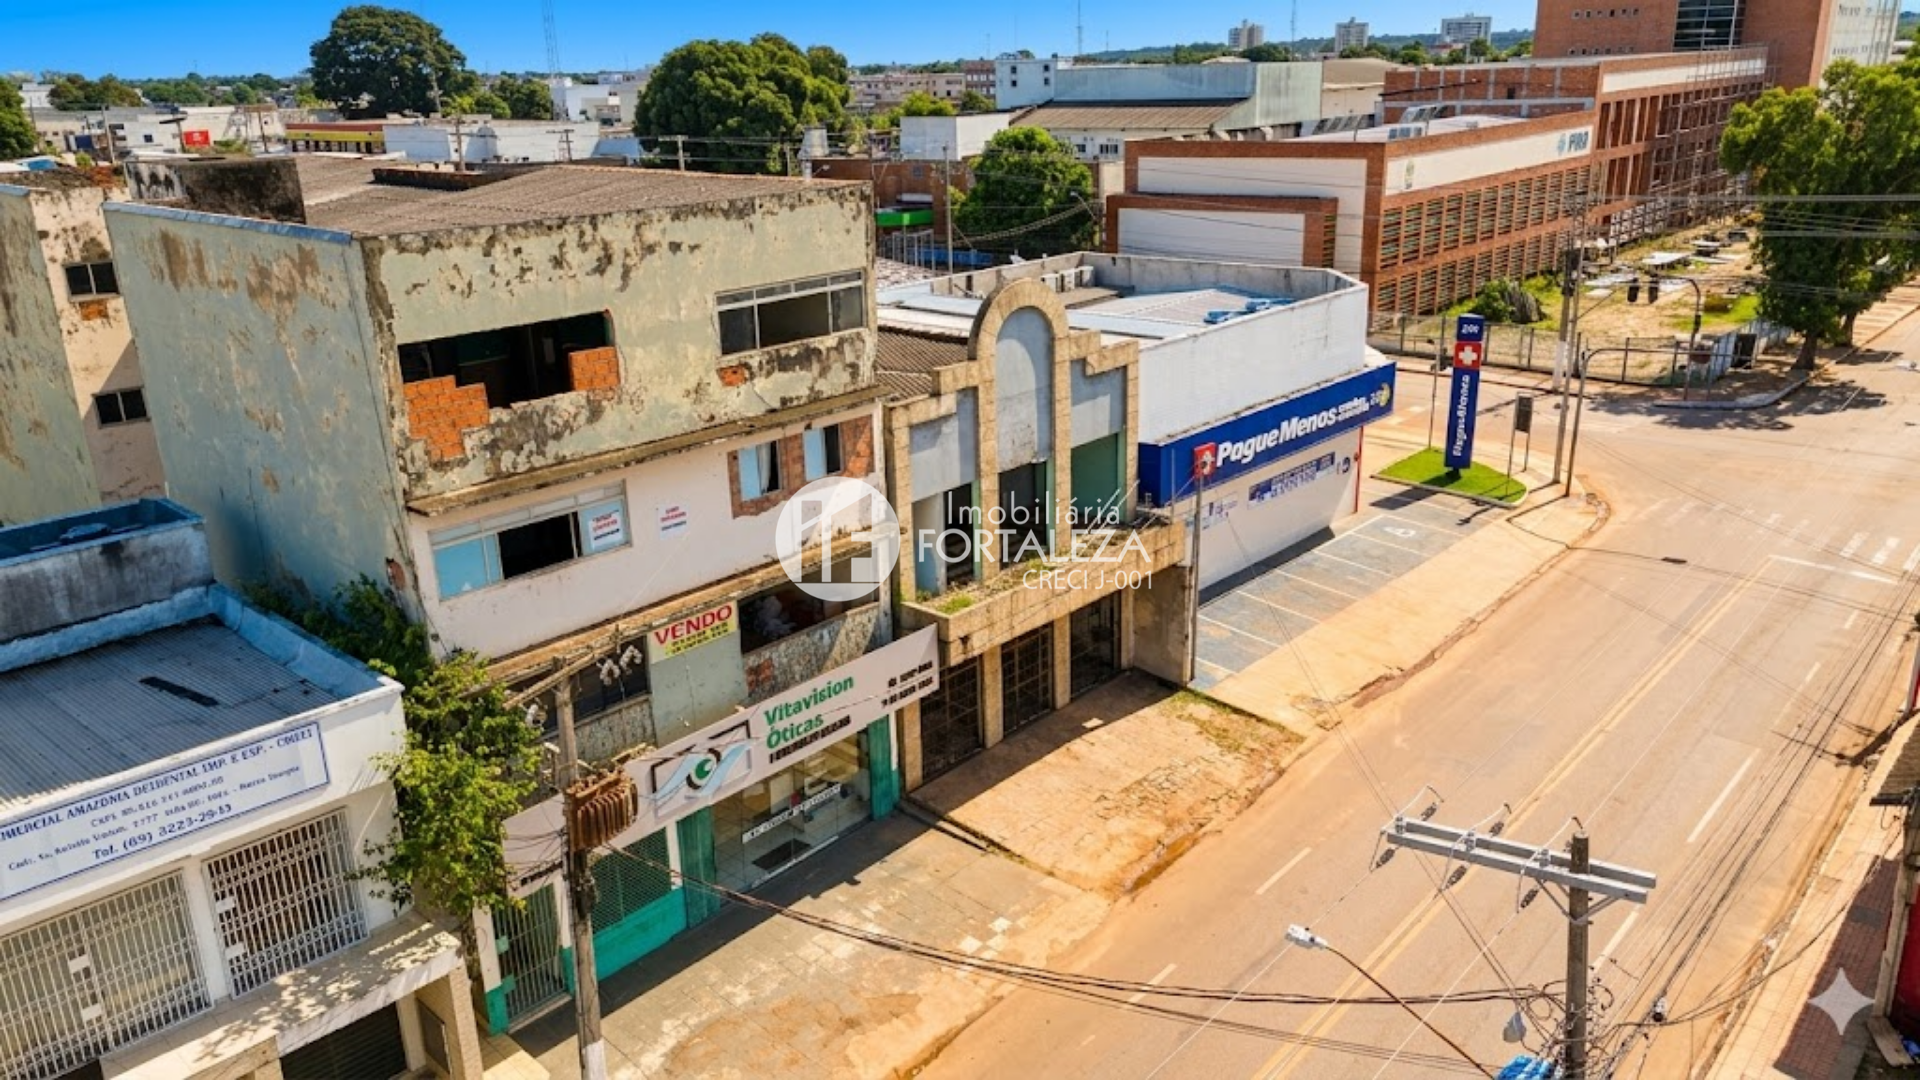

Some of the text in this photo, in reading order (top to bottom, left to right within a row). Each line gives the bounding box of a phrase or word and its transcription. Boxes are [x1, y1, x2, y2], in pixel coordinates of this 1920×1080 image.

[654, 604, 732, 645] VENDO
[764, 676, 854, 726] Vitavision
[766, 714, 824, 749] Óticas
